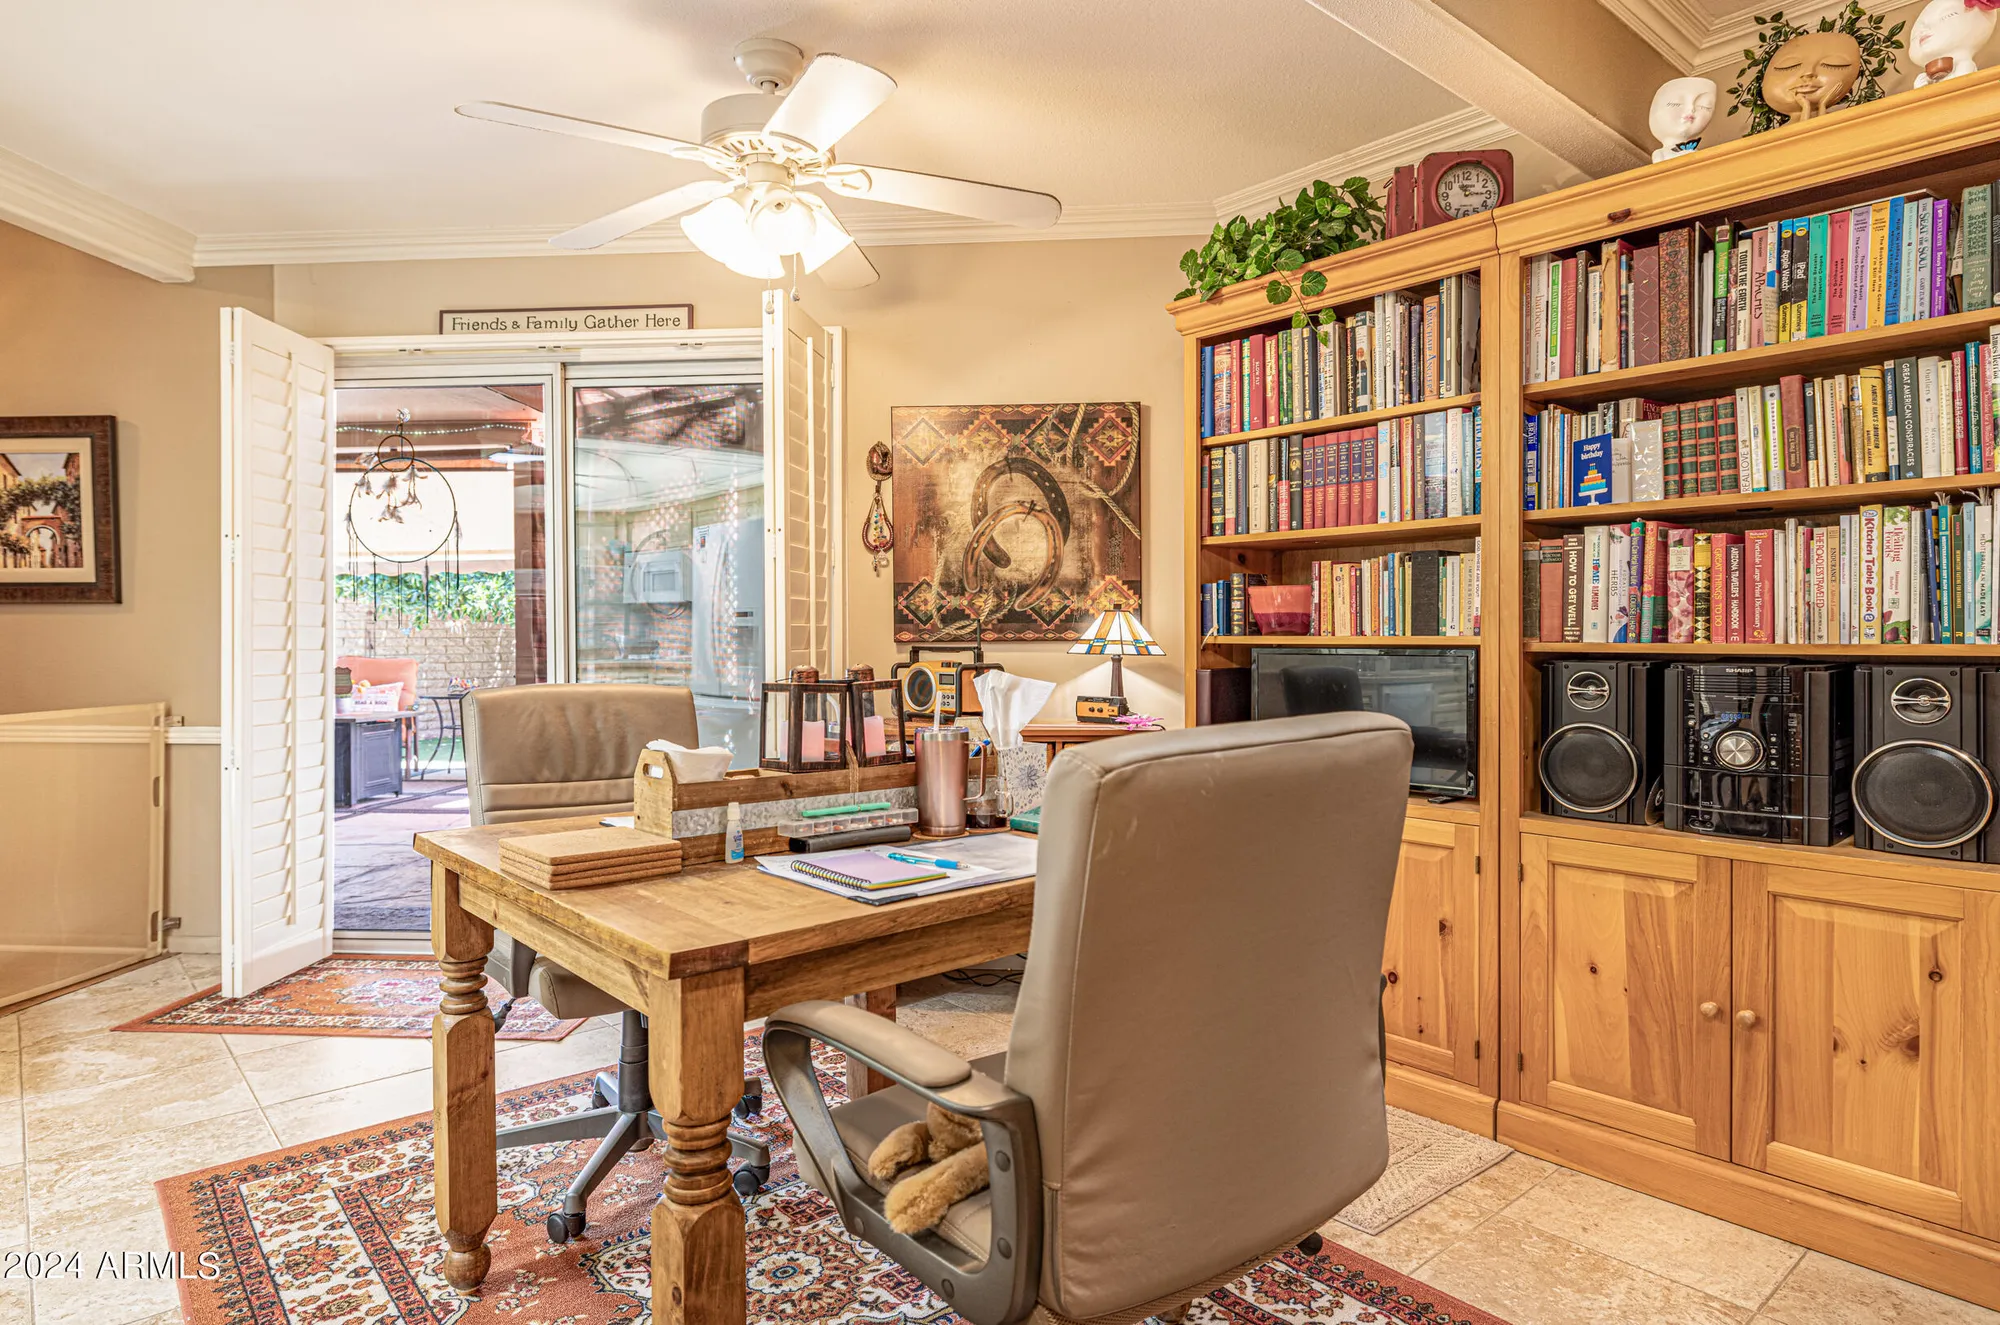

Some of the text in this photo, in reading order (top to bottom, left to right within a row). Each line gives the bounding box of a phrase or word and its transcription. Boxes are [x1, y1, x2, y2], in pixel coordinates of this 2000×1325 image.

[1444, 181, 1453, 190] 10
[1454, 174, 1460, 183] 11
[1463, 171, 1471, 180] 12
[1476, 173, 1479, 182] 1
[1482, 179, 1488, 188] 2
[1442, 192, 1448, 201] 9
[1482, 200, 1488, 209] 4
[1485, 190, 1491, 199] 3
[1445, 202, 1451, 211] 8
[1455, 208, 1461, 217] 7
[1463, 210, 1469, 218] 6
[1919, 212, 1930, 235] SEAT
[1781, 250, 1790, 269] Apple
[1918, 246, 1929, 271] SOUL
[1718, 252, 1727, 295] Magic Foods
[1738, 250, 1748, 311] TOUCH THE EARTH
[1781, 270, 1790, 291] Watch
[1797, 262, 1806, 279] iPad
[1754, 272, 1766, 319] APACHES
[452, 313, 681, 331] Friends & Family Gather Here
[1534, 294, 1545, 337] barbecue
[1426, 305, 1437, 389] ARMCHAIR ANGLER
[1871, 385, 1879, 405] ANOTHER
[1872, 407, 1880, 423] MAN'S
[1902, 363, 1915, 466] GREAT AMERICAN CONSPIRACIES
[1528, 423, 1536, 444] BRAIN
[1581, 450, 1604, 461] birthday
[1583, 443, 1601, 452] Happy
[1741, 452, 1751, 492] REAL LOVE
[1631, 537, 1639, 545] You
[1816, 532, 1825, 544] THE
[1864, 518, 1875, 555] Kitchen
[1885, 531, 1894, 558] Foods
[1892, 527, 1903, 563] Healing
[1816, 544, 1825, 564] ROAD
[1592, 558, 1601, 585] HOME
[1630, 575, 1638, 584] Life
[1816, 564, 1825, 576] LESS
[1865, 557, 1875, 585] Table
[1567, 551, 1577, 627] HOW TO GET WELL
[1713, 548, 1723, 627] GREAT THINGS TO DO
[1731, 547, 1739, 629] ARIZONA TRAVELER'S HANDBOOK
[1814, 576, 1825, 609] TRAVELED
[1591, 585, 1600, 611] REMEDIES
[1629, 595, 1637, 615] LOUISE
[1865, 586, 1876, 613] Book
[1753, 598, 1762, 628] Dictionary
